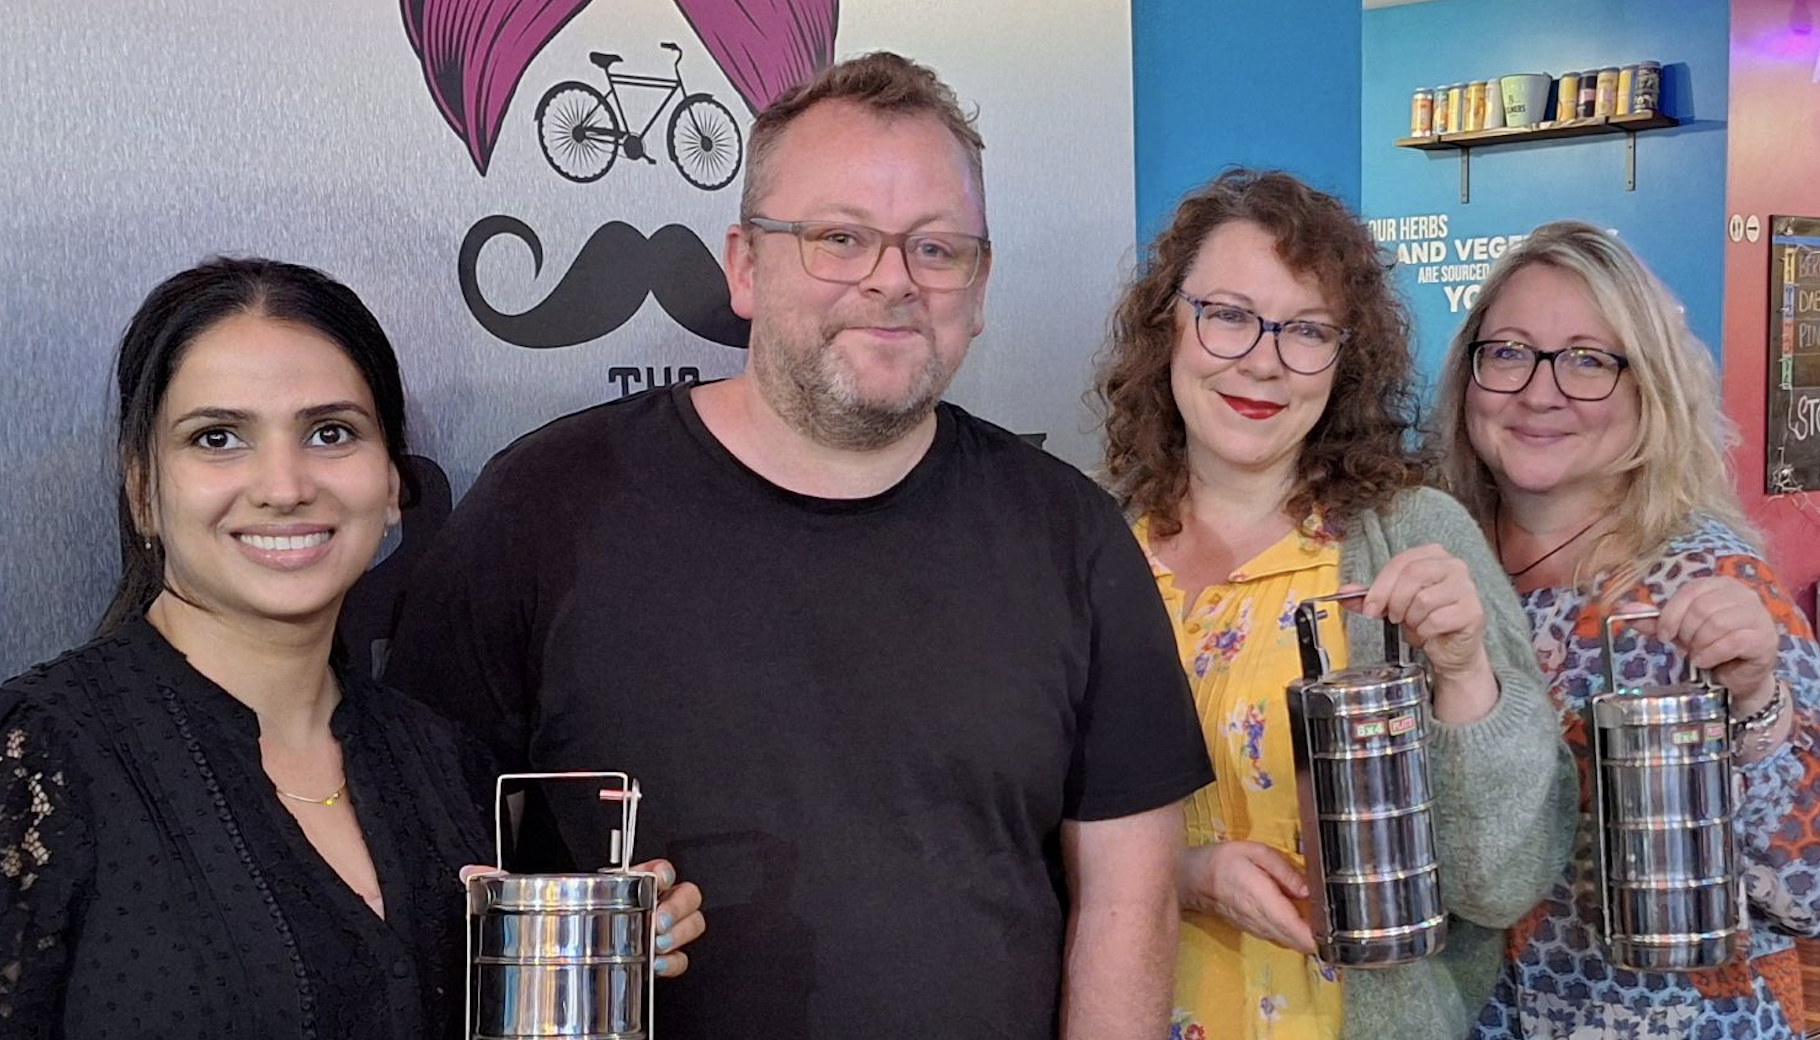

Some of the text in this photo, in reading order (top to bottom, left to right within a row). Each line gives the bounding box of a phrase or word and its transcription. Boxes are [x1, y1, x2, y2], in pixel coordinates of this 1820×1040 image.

[1368, 214, 1449, 243] OUR HERBS
[1398, 240, 1447, 265] AND
[1417, 262, 1490, 284] ARE SOURCED
[1443, 283, 1482, 313] YO
[1797, 395, 1820, 440] ST
